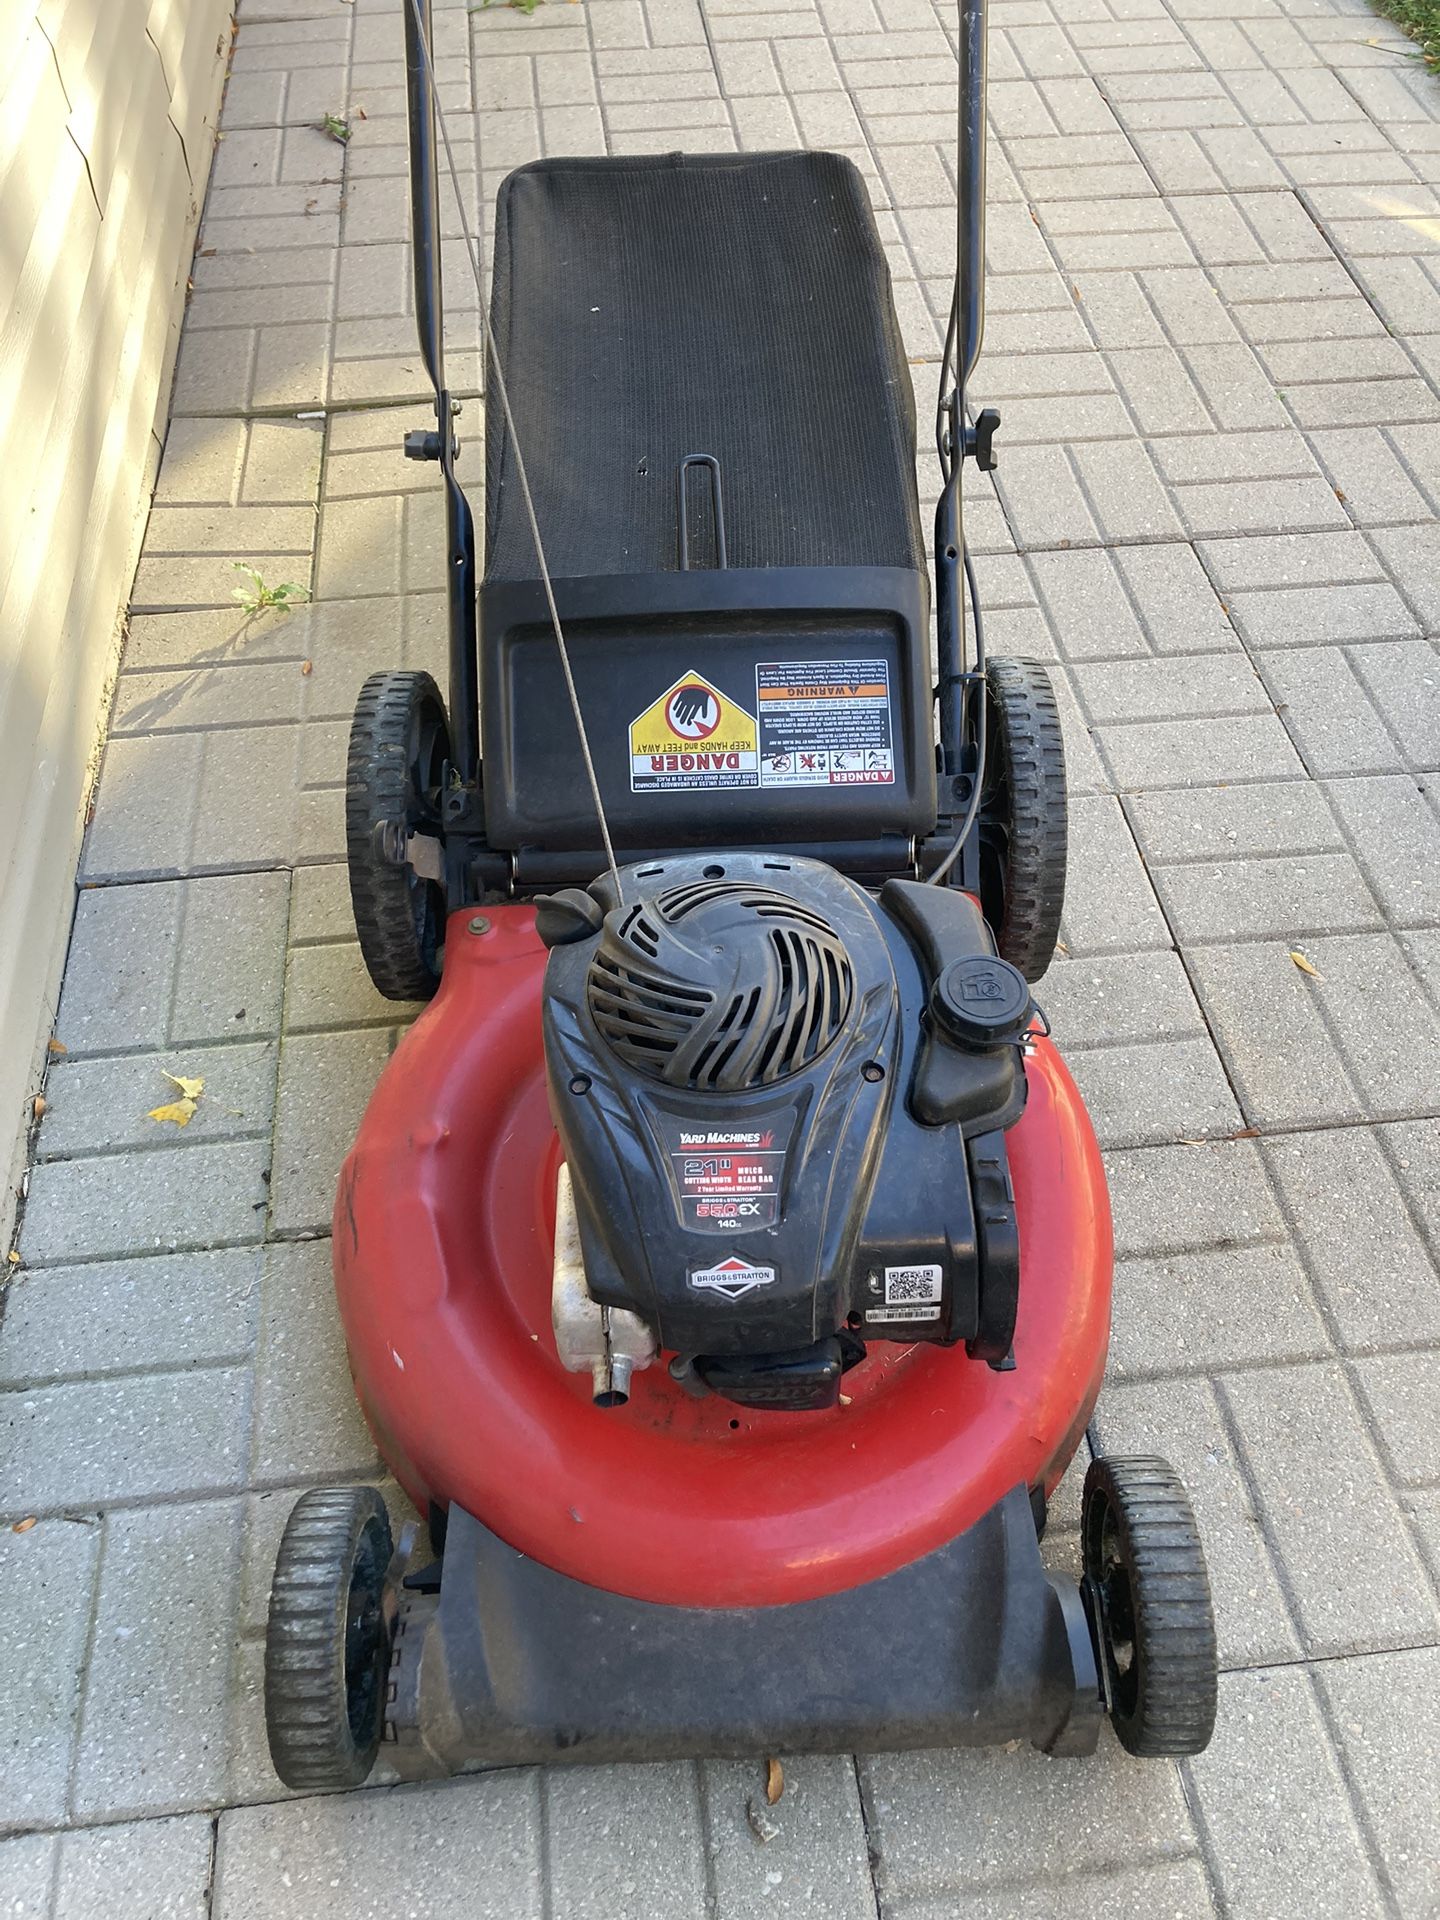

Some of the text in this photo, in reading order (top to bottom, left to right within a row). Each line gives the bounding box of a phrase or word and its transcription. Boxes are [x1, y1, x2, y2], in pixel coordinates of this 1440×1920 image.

[787, 687, 845, 696] WARNING
[637, 741, 750, 753] KEEP HANDS and FEET AWAY
[650, 753, 740, 771] DANGER
[833, 771, 878, 782] DANGER
[680, 1132, 760, 1144] YARD MACHINES
[684, 1159, 731, 1176] 21"
[738, 1166, 763, 1174] MULCH
[738, 1176, 757, 1184] REAR
